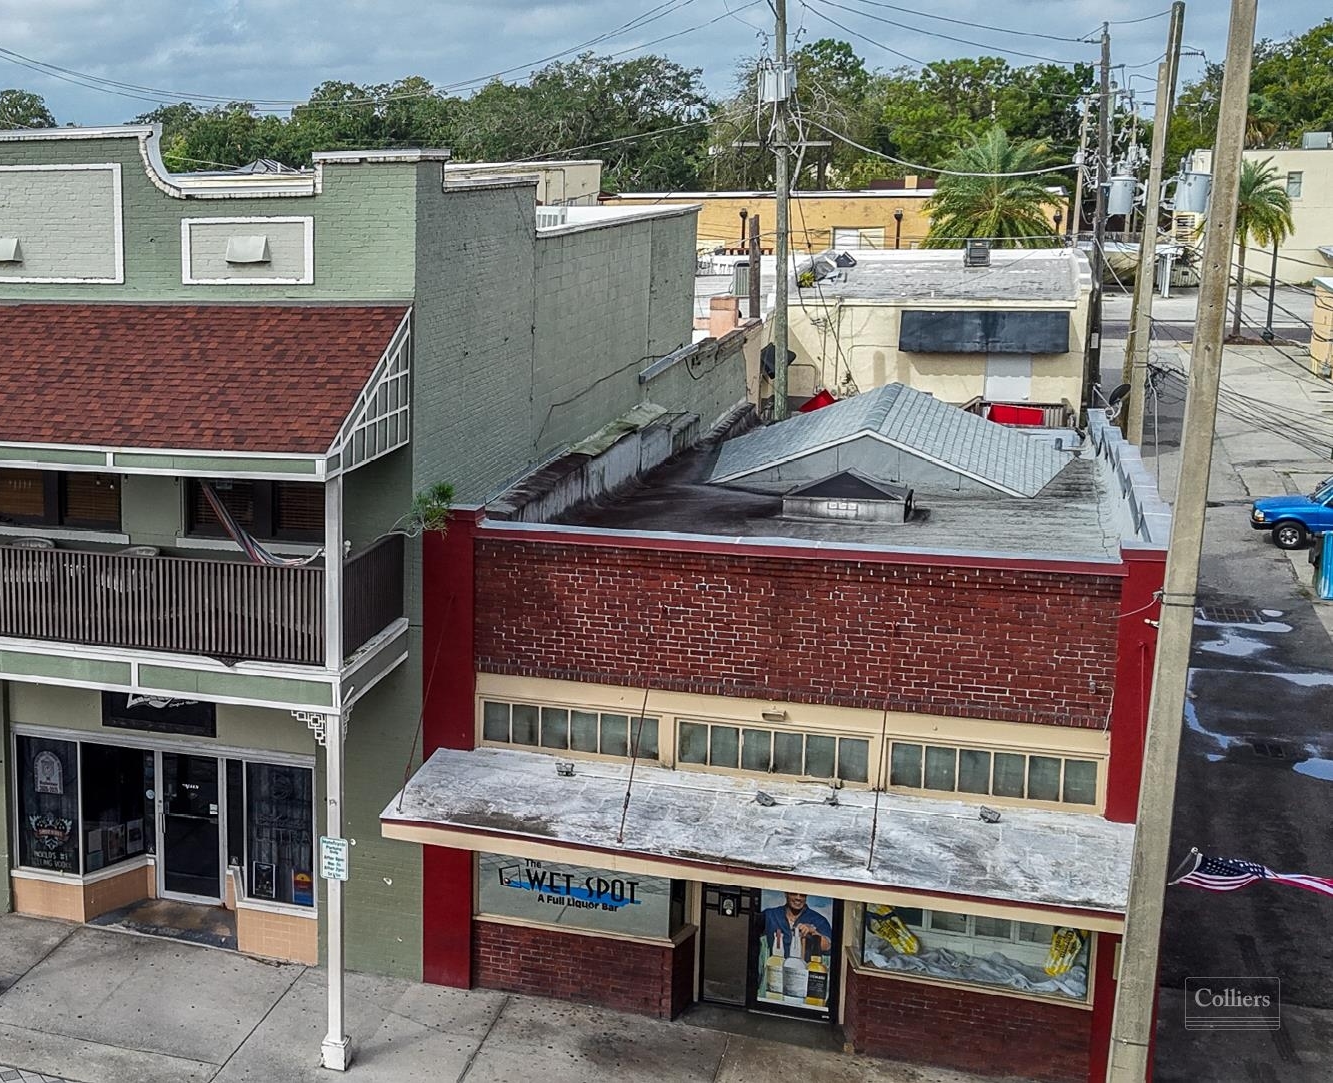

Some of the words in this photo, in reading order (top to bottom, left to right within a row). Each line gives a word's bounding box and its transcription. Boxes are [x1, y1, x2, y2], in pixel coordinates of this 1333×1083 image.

[524, 858, 542, 869] The
[525, 869, 575, 895] WET
[585, 876, 639, 904] SPOT
[537, 894, 545, 903] A
[547, 896, 565, 906] Full
[567, 898, 600, 910] Liquor
[602, 903, 619, 912] Bar
